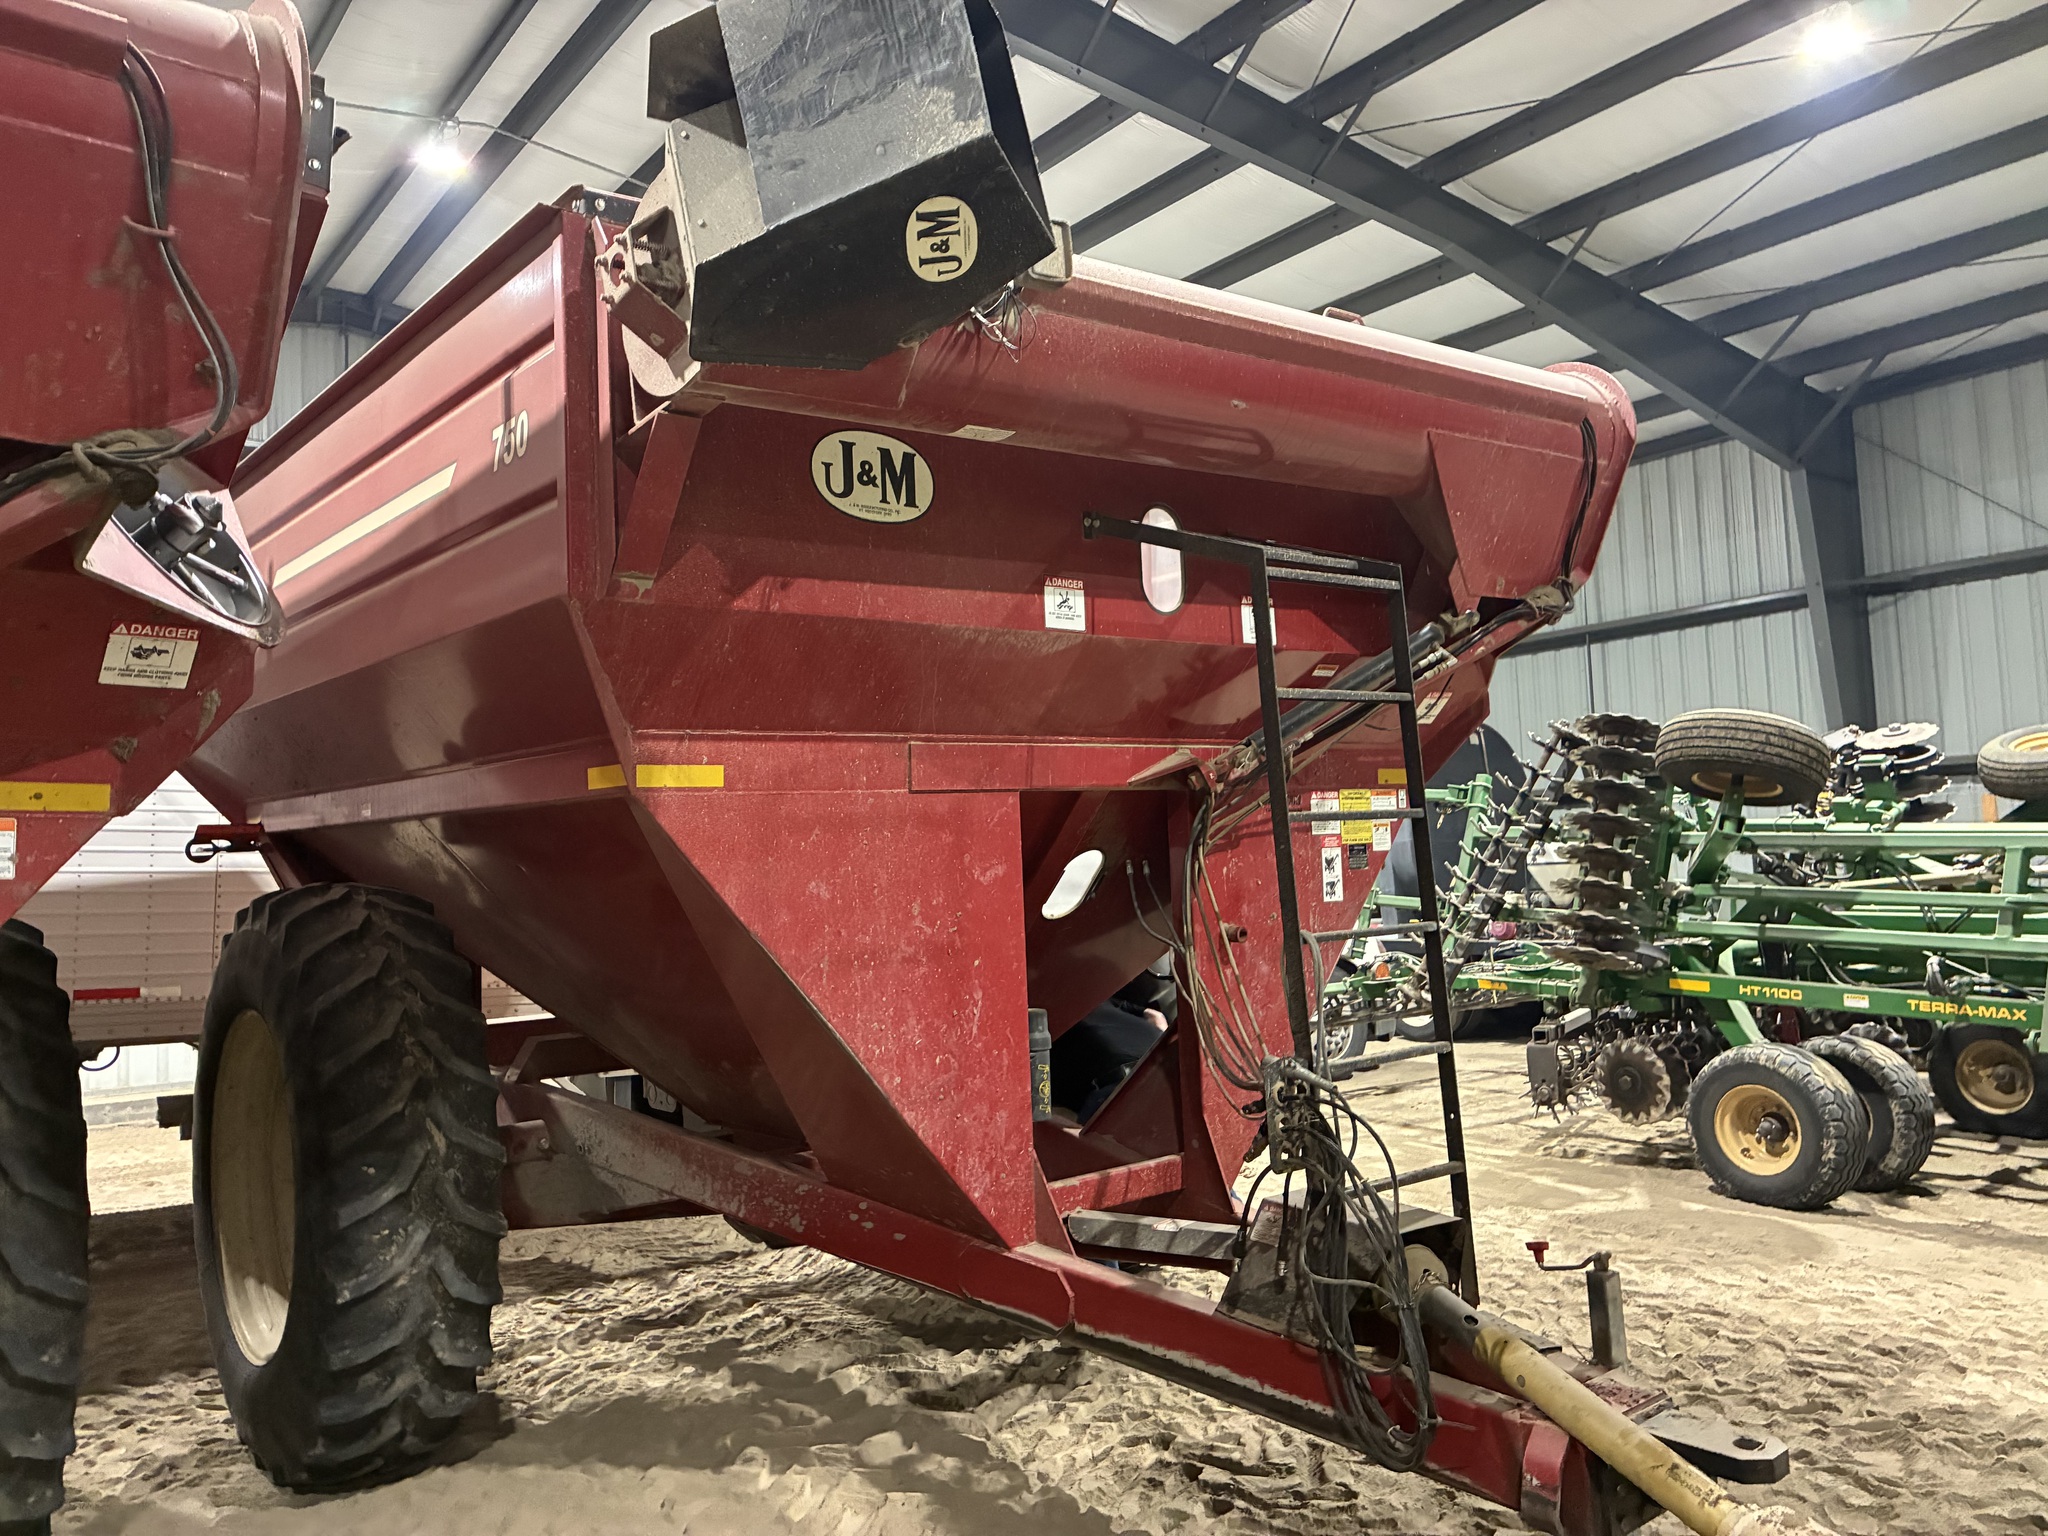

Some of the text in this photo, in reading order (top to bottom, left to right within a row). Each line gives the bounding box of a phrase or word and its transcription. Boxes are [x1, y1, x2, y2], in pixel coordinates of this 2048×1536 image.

[915, 205, 962, 277] J&M
[492, 409, 528, 473] 750
[821, 440, 919, 508] J&M
[1052, 578, 1084, 589] DANGER
[130, 624, 199, 639] DANGER
[1316, 791, 1338, 799] DANGER
[1739, 984, 1802, 1000] HT1100
[1907, 999, 2027, 1021] TERRA-MAX
